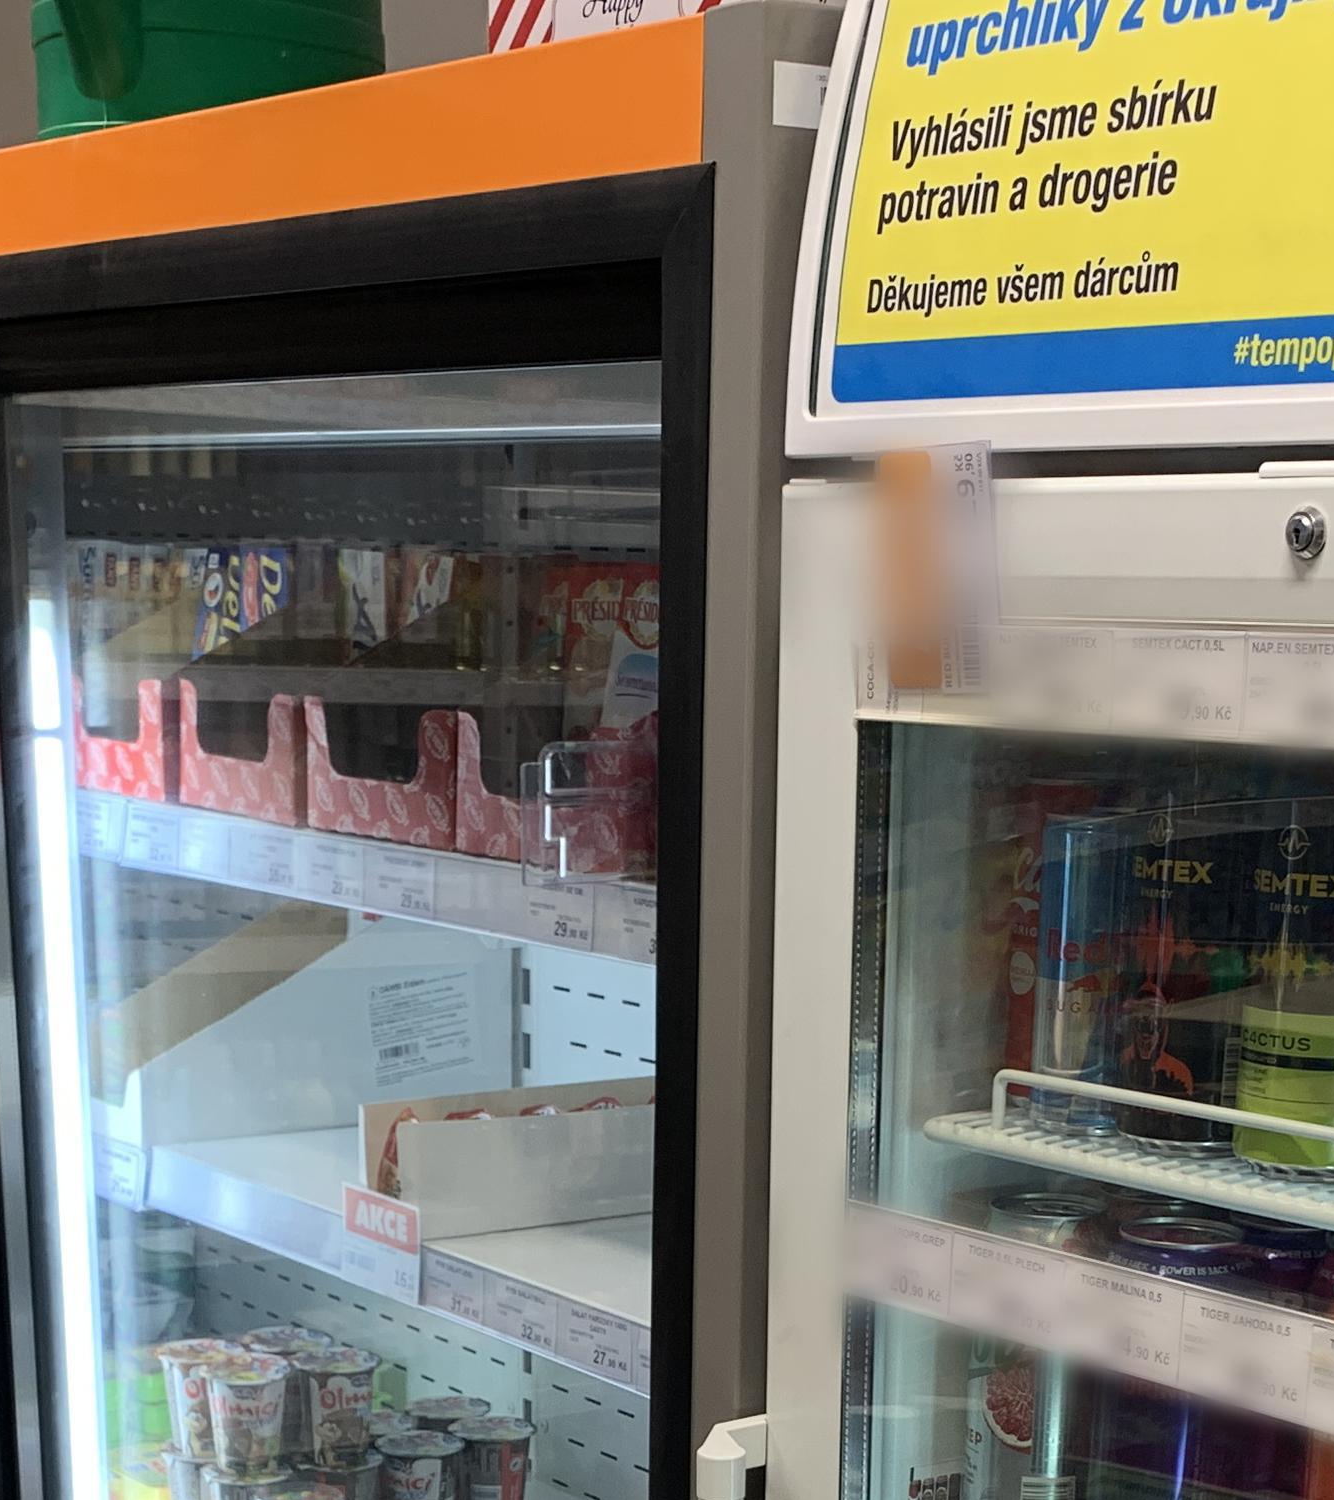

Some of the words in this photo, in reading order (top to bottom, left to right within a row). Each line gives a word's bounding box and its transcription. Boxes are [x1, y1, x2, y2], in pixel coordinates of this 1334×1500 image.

[892, 104, 1014, 169] Vyhlásili
[1015, 100, 1097, 155] jsme
[1107, 79, 1217, 134] sbírku
[877, 172, 999, 235] potravin
[1009, 178, 1027, 211] a
[1038, 152, 1178, 216] drogerie
[867, 274, 988, 318] Děkujeme
[996, 263, 1065, 305] všem
[1072, 250, 1180, 298] dárcům
[352, 1199, 409, 1244] AKCE
[1080, 1273, 1109, 1291] TIGER
[1109, 1279, 1148, 1299] MALINA
[1199, 1305, 1231, 1324] TIGER
[1232, 1312, 1274, 1333] JAHODA
[1153, 1350, 1171, 1367] Kč
